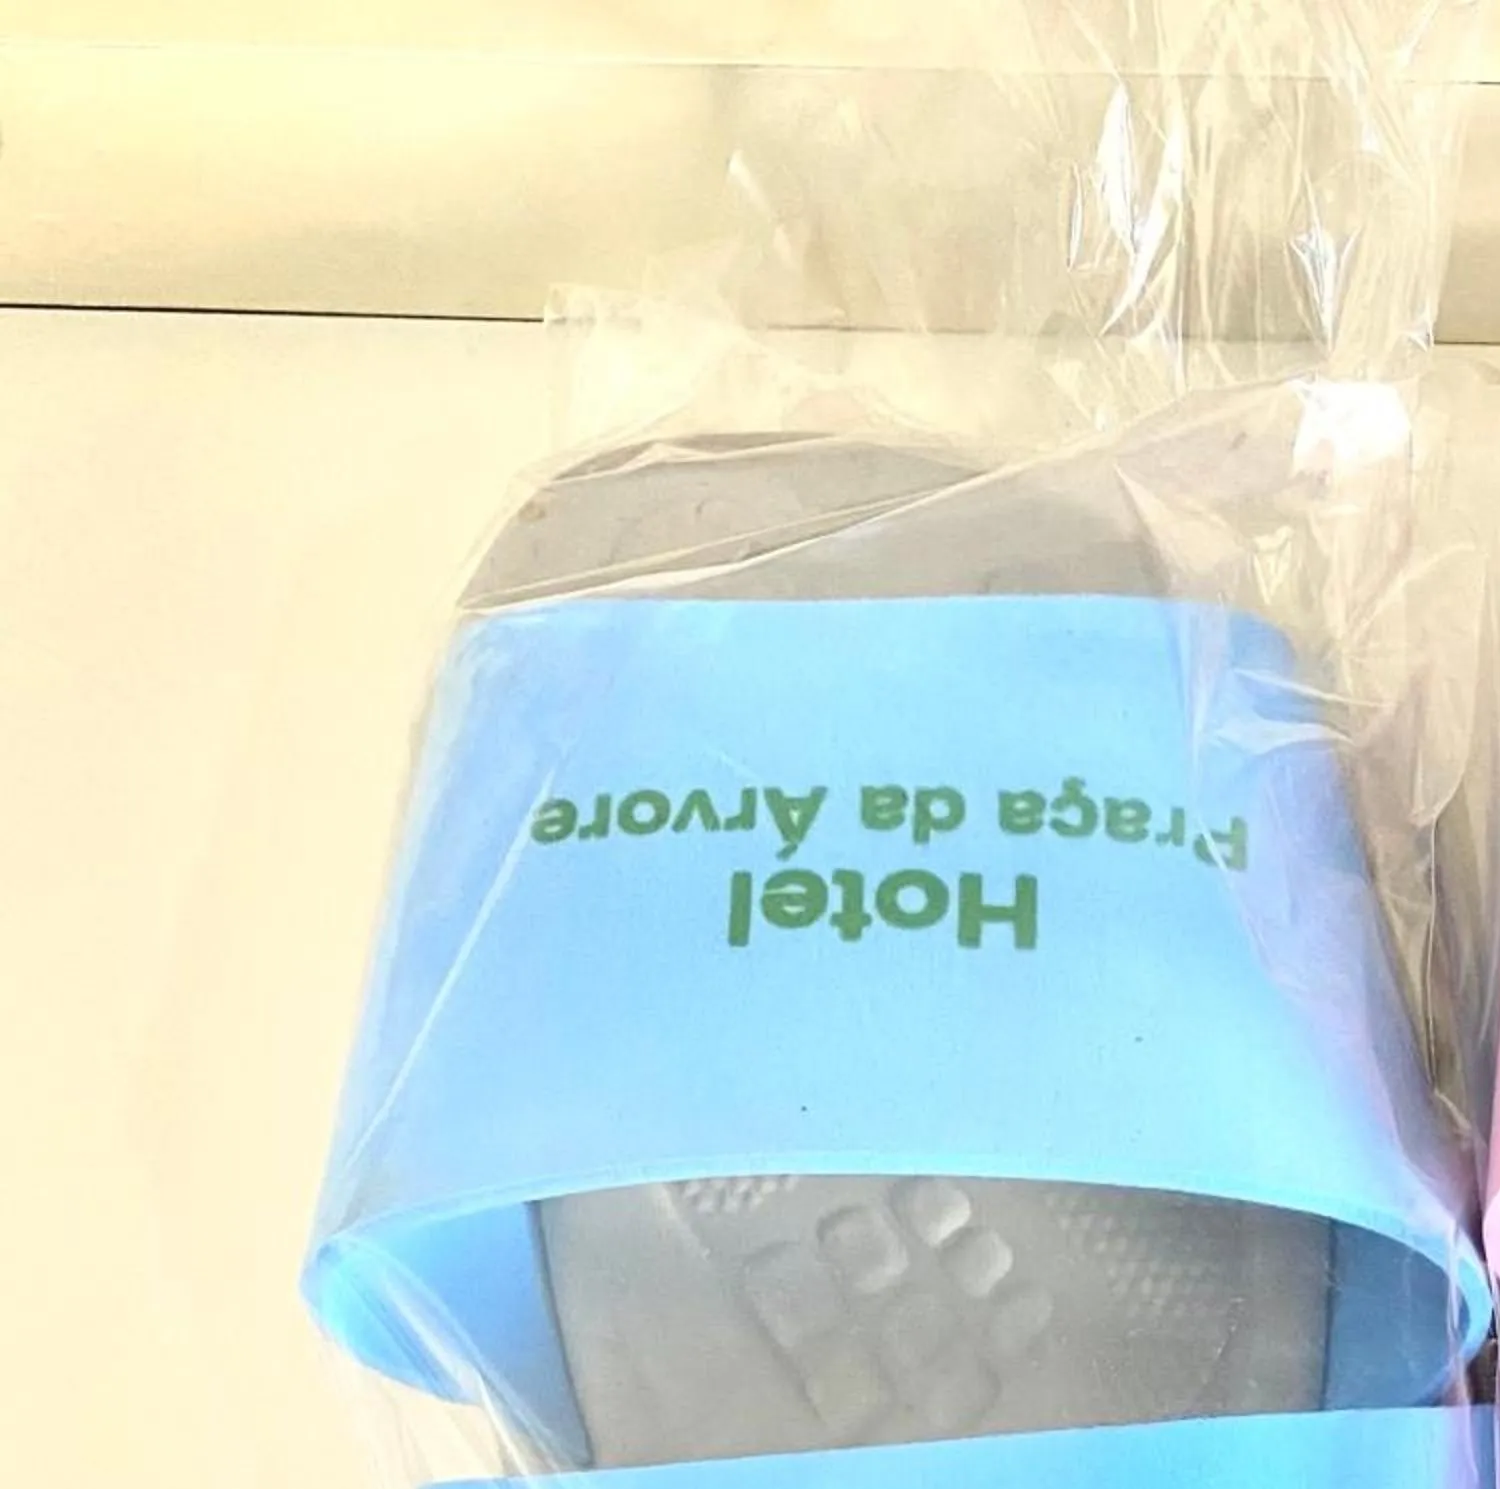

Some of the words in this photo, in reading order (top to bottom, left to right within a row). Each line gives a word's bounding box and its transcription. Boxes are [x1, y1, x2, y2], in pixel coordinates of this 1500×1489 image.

[529, 784, 829, 861] Árvore
[860, 784, 966, 844] da
[997, 777, 1248, 871] Praça
[727, 867, 1038, 950] Hotel
